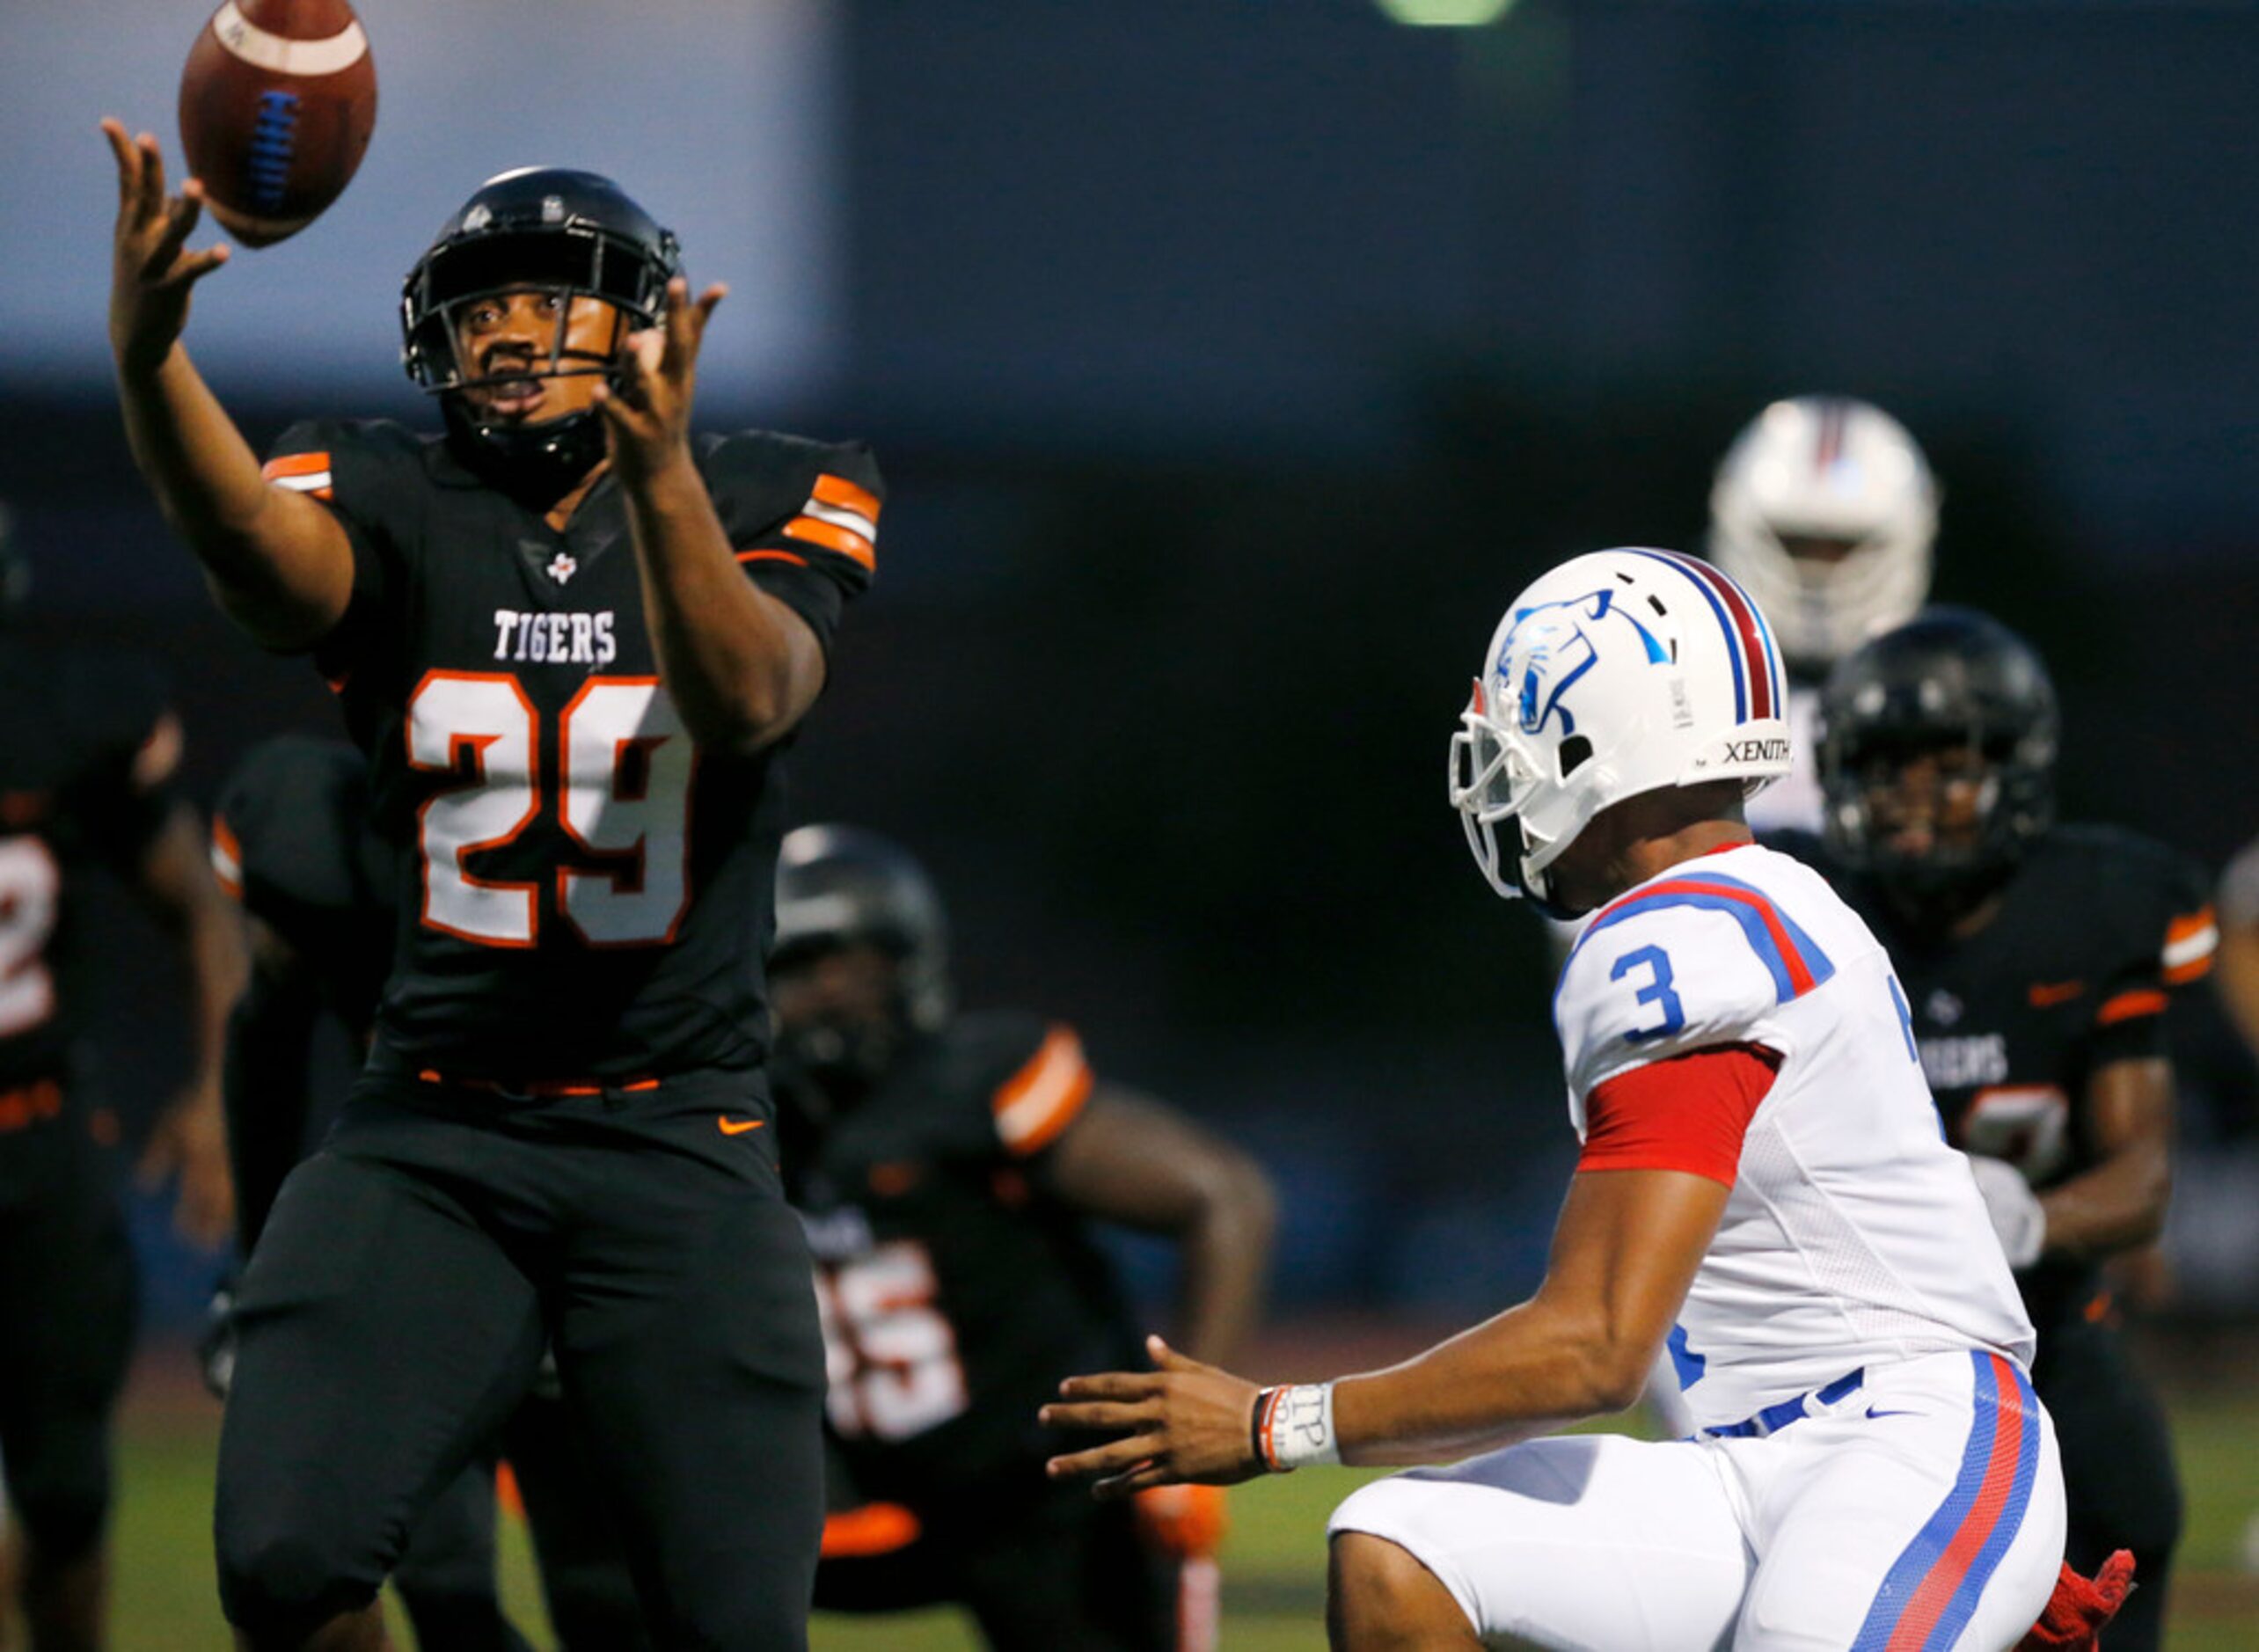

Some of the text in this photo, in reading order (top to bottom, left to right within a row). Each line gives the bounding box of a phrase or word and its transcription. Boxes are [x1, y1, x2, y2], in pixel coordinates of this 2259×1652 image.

[493, 609, 617, 663] TIGERS
[405, 669, 698, 950] 29
[1611, 943, 1686, 1043] 3
